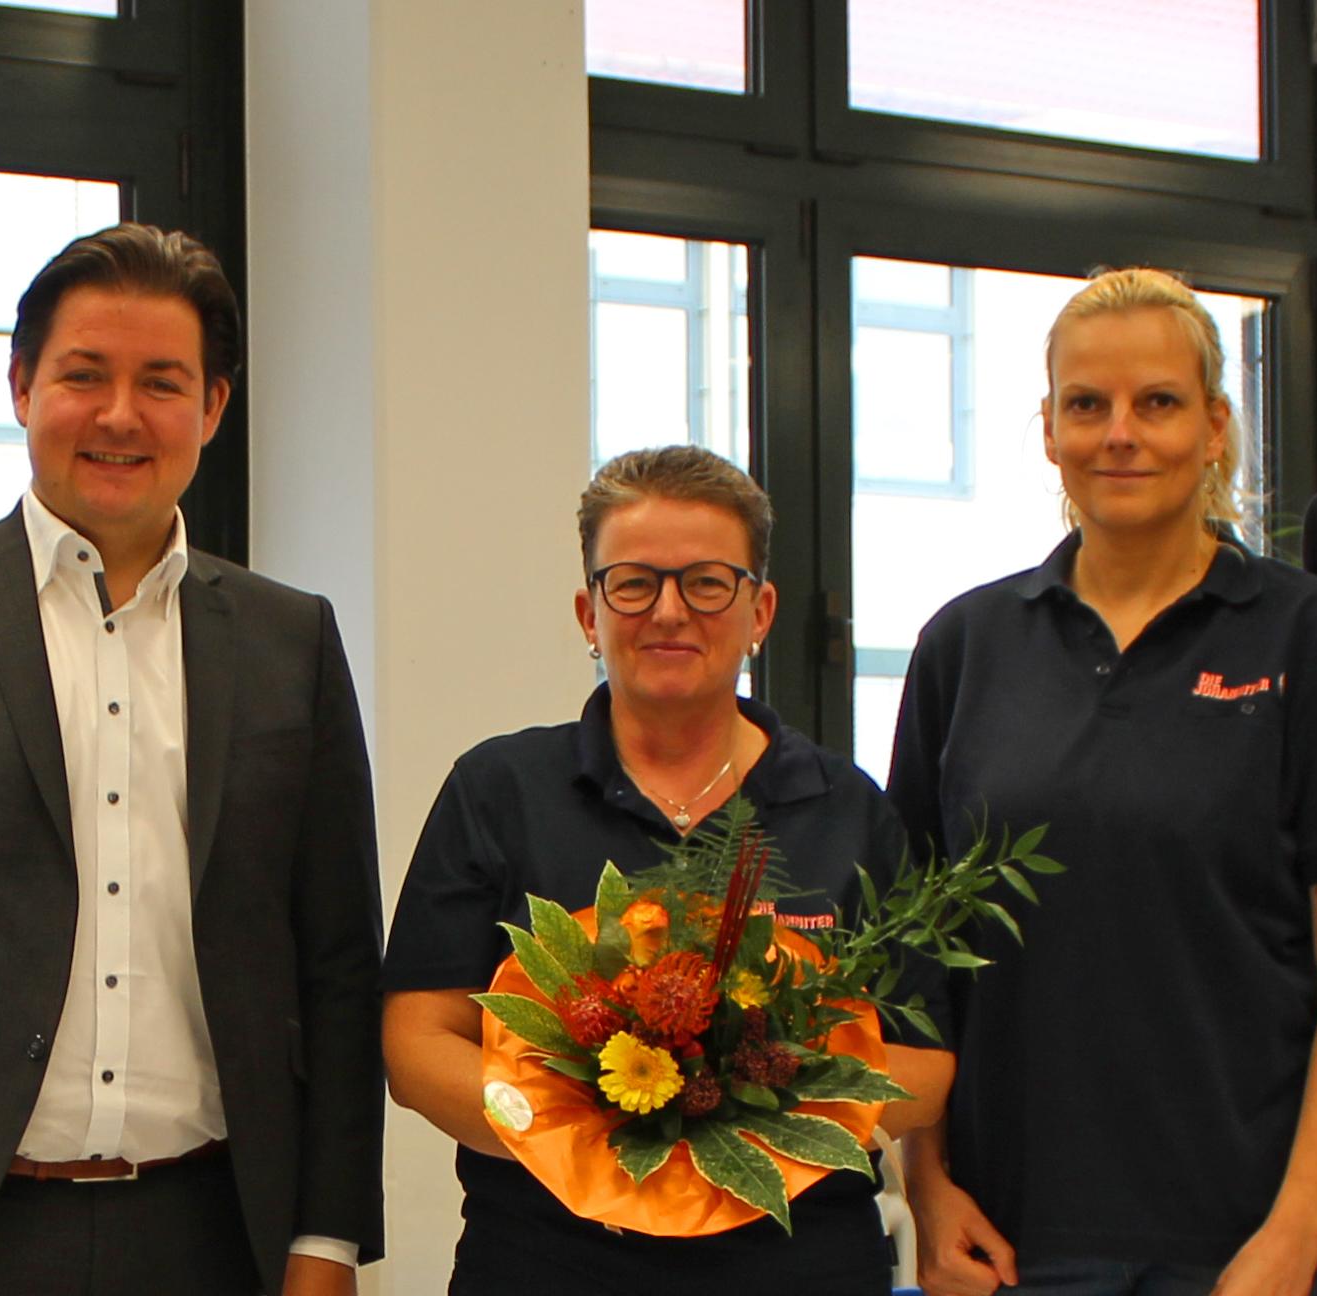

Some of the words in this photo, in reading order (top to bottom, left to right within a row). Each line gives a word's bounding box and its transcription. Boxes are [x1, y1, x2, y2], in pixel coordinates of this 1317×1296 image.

[1200, 672, 1223, 685] DIE
[1193, 678, 1270, 700] JOHANITR
[777, 914, 834, 929] ANNITER
